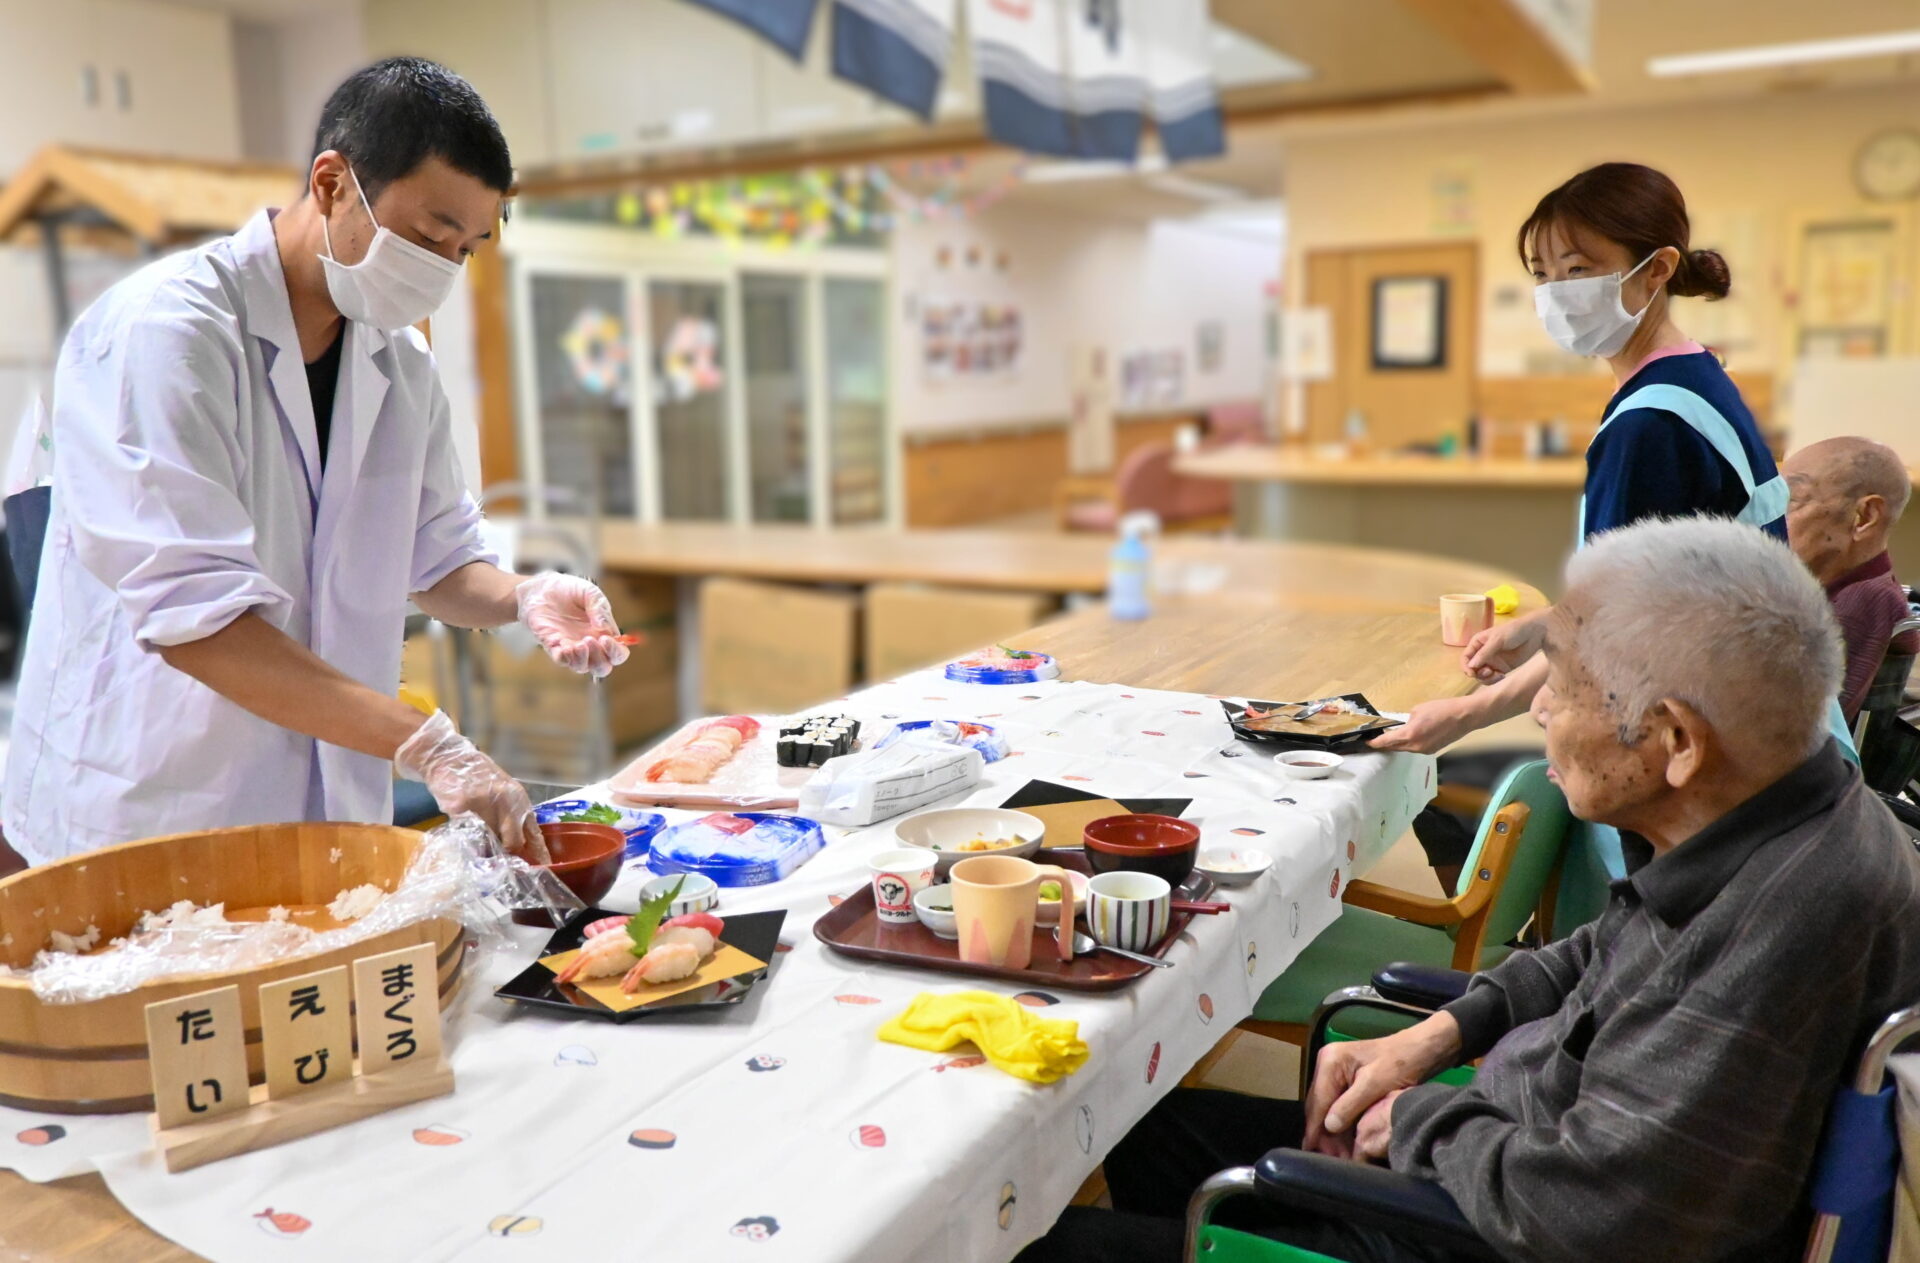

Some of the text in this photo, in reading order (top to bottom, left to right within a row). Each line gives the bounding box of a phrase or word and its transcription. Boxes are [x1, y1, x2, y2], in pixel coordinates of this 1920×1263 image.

[177, 1008, 222, 1113] たい
[289, 985, 329, 1084] えび
[382, 963, 417, 1060] まぐろ
